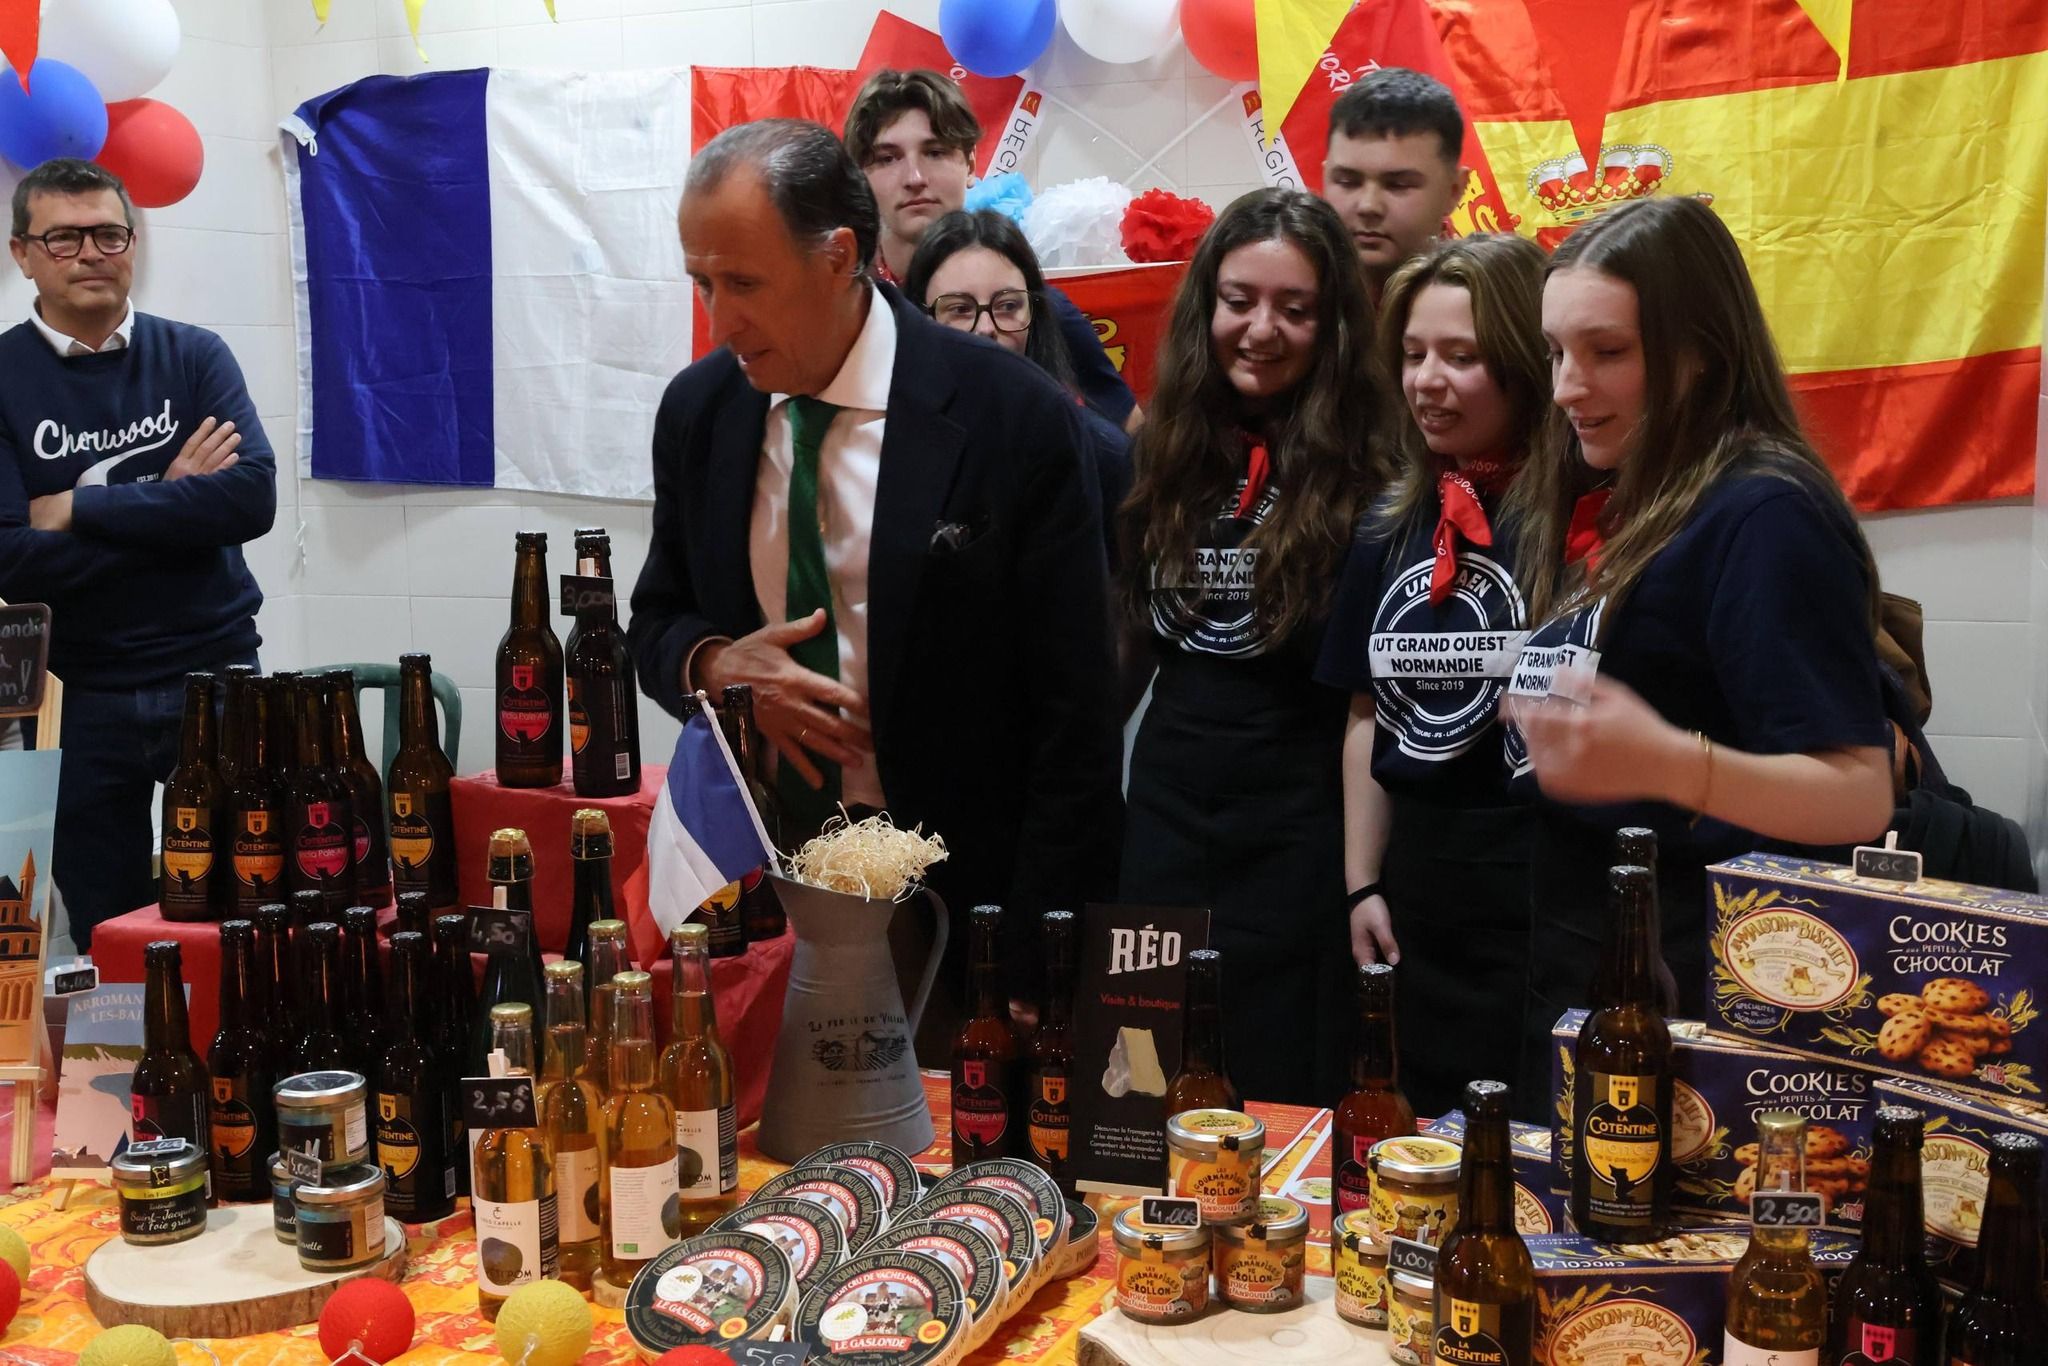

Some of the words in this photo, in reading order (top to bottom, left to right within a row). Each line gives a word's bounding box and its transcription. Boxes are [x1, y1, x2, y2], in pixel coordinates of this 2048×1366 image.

[1227, 592, 1250, 600] 2019
[1373, 638, 1394, 652] IUT
[1396, 638, 1449, 652] GRAND
[1453, 636, 1507, 651] OUEST
[1391, 658, 1484, 673] NORMANDIE
[1416, 680, 1439, 691] Since
[1442, 680, 1465, 691] 2019
[166, 836, 210, 849] COTENTINE
[1889, 915, 2008, 948] COOKIES
[1109, 923, 1181, 975] RÉO
[1738, 916, 1791, 948] MAISON
[1798, 920, 1851, 967] BISCUIT
[1922, 944, 1957, 954] PEPITES
[1893, 955, 2005, 977] CHOCOLAT
[74, 994, 144, 1013] ARROMAN
[1100, 993, 1126, 1006] Visite
[1128, 995, 1136, 1006] &
[1138, 996, 1181, 1011] boutique
[1746, 1069, 1866, 1097] COOKIES
[1780, 1095, 1815, 1103] PEPITES
[1127, 1128, 1155, 1137] Fromagerie
[1589, 1116, 1657, 1135] COTENTINE
[1090, 1141, 1118, 1149] Camembert
[1127, 1144, 1155, 1152] Normandie
[1131, 1136, 1158, 1144] fabrication
[862, 1160, 872, 1168] DE
[977, 1164, 1018, 1177] APPELLATION
[793, 1184, 804, 1192] LAIT
[804, 1182, 817, 1190] CRU
[818, 1183, 828, 1191] DE
[829, 1185, 852, 1204] VACHES
[1203, 1187, 1240, 1197] ROLLON
[924, 1191, 964, 1212] NORMANDIE
[968, 1190, 1010, 1207] APPELLATION
[736, 1202, 776, 1224] CAMEMBERT
[935, 1208, 951, 1219] CRU
[950, 1206, 962, 1215] DE
[962, 1206, 989, 1218] VACHES
[787, 1216, 800, 1227] CRU
[891, 1223, 934, 1242] NORMANDIE
[937, 1223, 977, 1247] APPELLATION
[904, 1239, 919, 1250] CRU
[919, 1239, 930, 1248] DE
[930, 1239, 957, 1252] VACHES
[696, 1252, 709, 1262] LAIT
[709, 1250, 724, 1259] CRU
[724, 1250, 735, 1258] DE
[834, 1257, 875, 1286] NORMANDIE
[879, 1255, 922, 1270] APPELLATION
[1235, 1273, 1273, 1283] ROLLON
[831, 1293, 839, 1303] AU
[837, 1284, 848, 1298] LAIT
[846, 1276, 863, 1290] CRU
[863, 1272, 876, 1284] DE
[876, 1271, 905, 1281] VACHES
[1134, 1284, 1172, 1295] ROLLON
[656, 1299, 670, 1310] LE
[668, 1303, 712, 1332] GASLONDE
[1566, 1308, 1622, 1347] MAISON
[1632, 1307, 1688, 1348] BISCUIT
[834, 1339, 849, 1351] LE
[850, 1336, 908, 1349] GASLONDE
[1436, 1338, 1502, 1363] COTENTINE
[1459, 1341, 1470, 1349] LA
